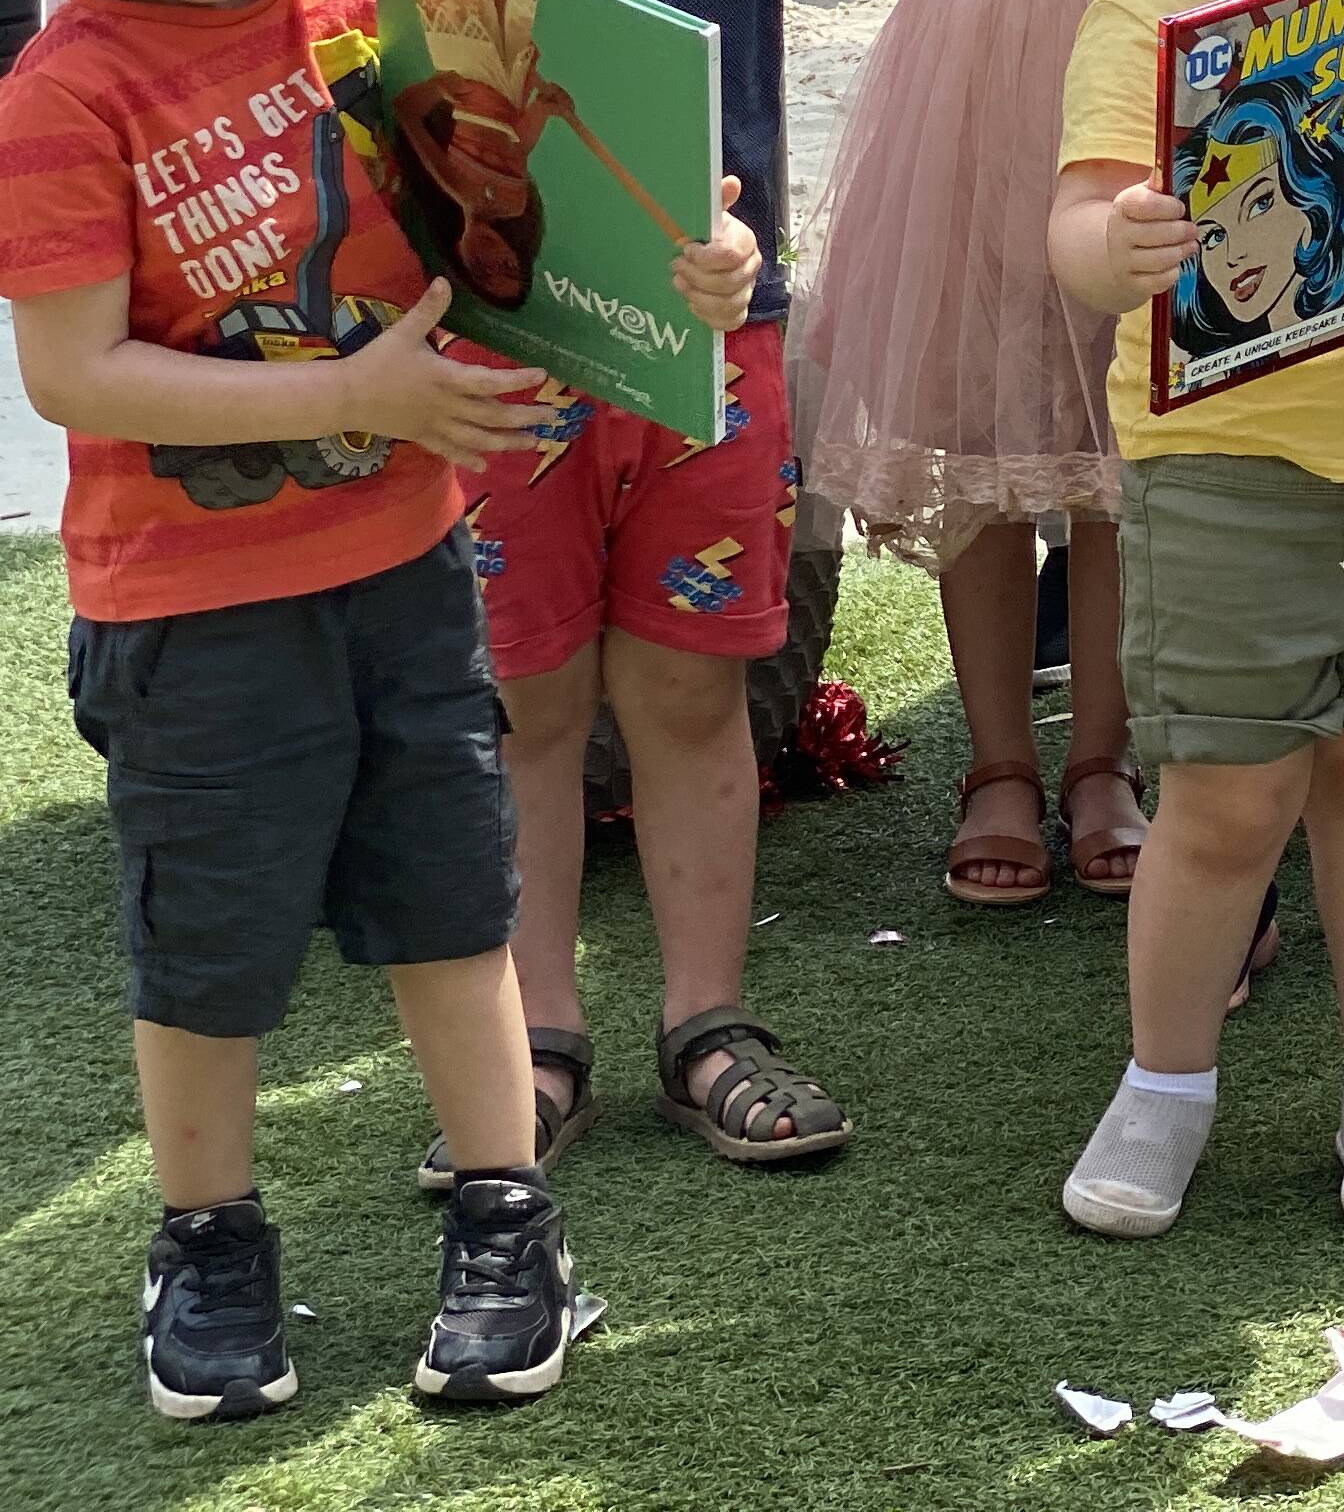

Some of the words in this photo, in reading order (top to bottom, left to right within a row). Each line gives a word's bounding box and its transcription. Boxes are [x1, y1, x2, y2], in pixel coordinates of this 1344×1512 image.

[1186, 43, 1232, 83] DC
[134, 116, 246, 208] LET'S
[248, 68, 326, 138] GET
[154, 152, 301, 255] THINGS
[180, 217, 292, 299] DONE
[543, 271, 690, 356] MOANA
[1191, 355, 1231, 377] CREATE
[1234, 350, 1242, 361] A
[1245, 335, 1282, 357] UNIQUE
[1285, 316, 1337, 343] KEEPSAKE
